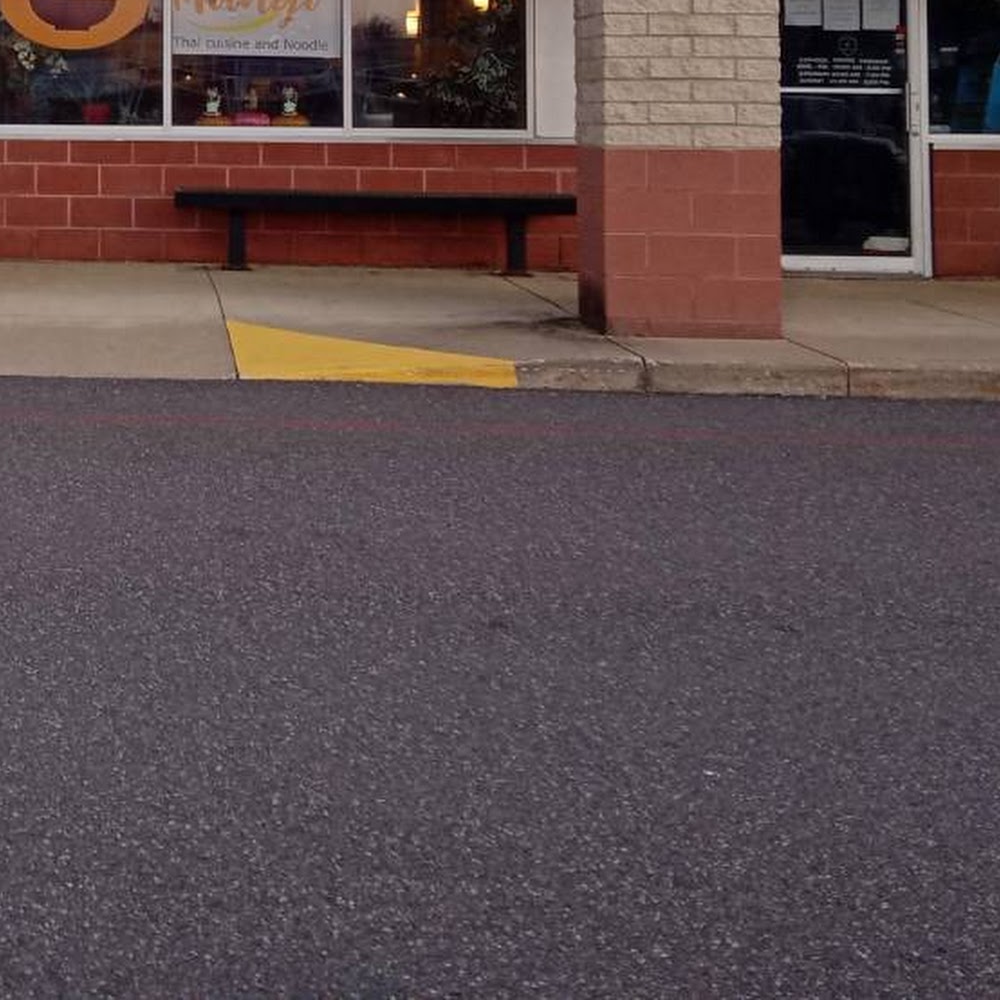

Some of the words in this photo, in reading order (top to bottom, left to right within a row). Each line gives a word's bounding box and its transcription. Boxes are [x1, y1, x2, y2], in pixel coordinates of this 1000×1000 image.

[174, 36, 200, 49] Thai
[254, 37, 280, 50] and
[283, 38, 329, 52] Noodle
